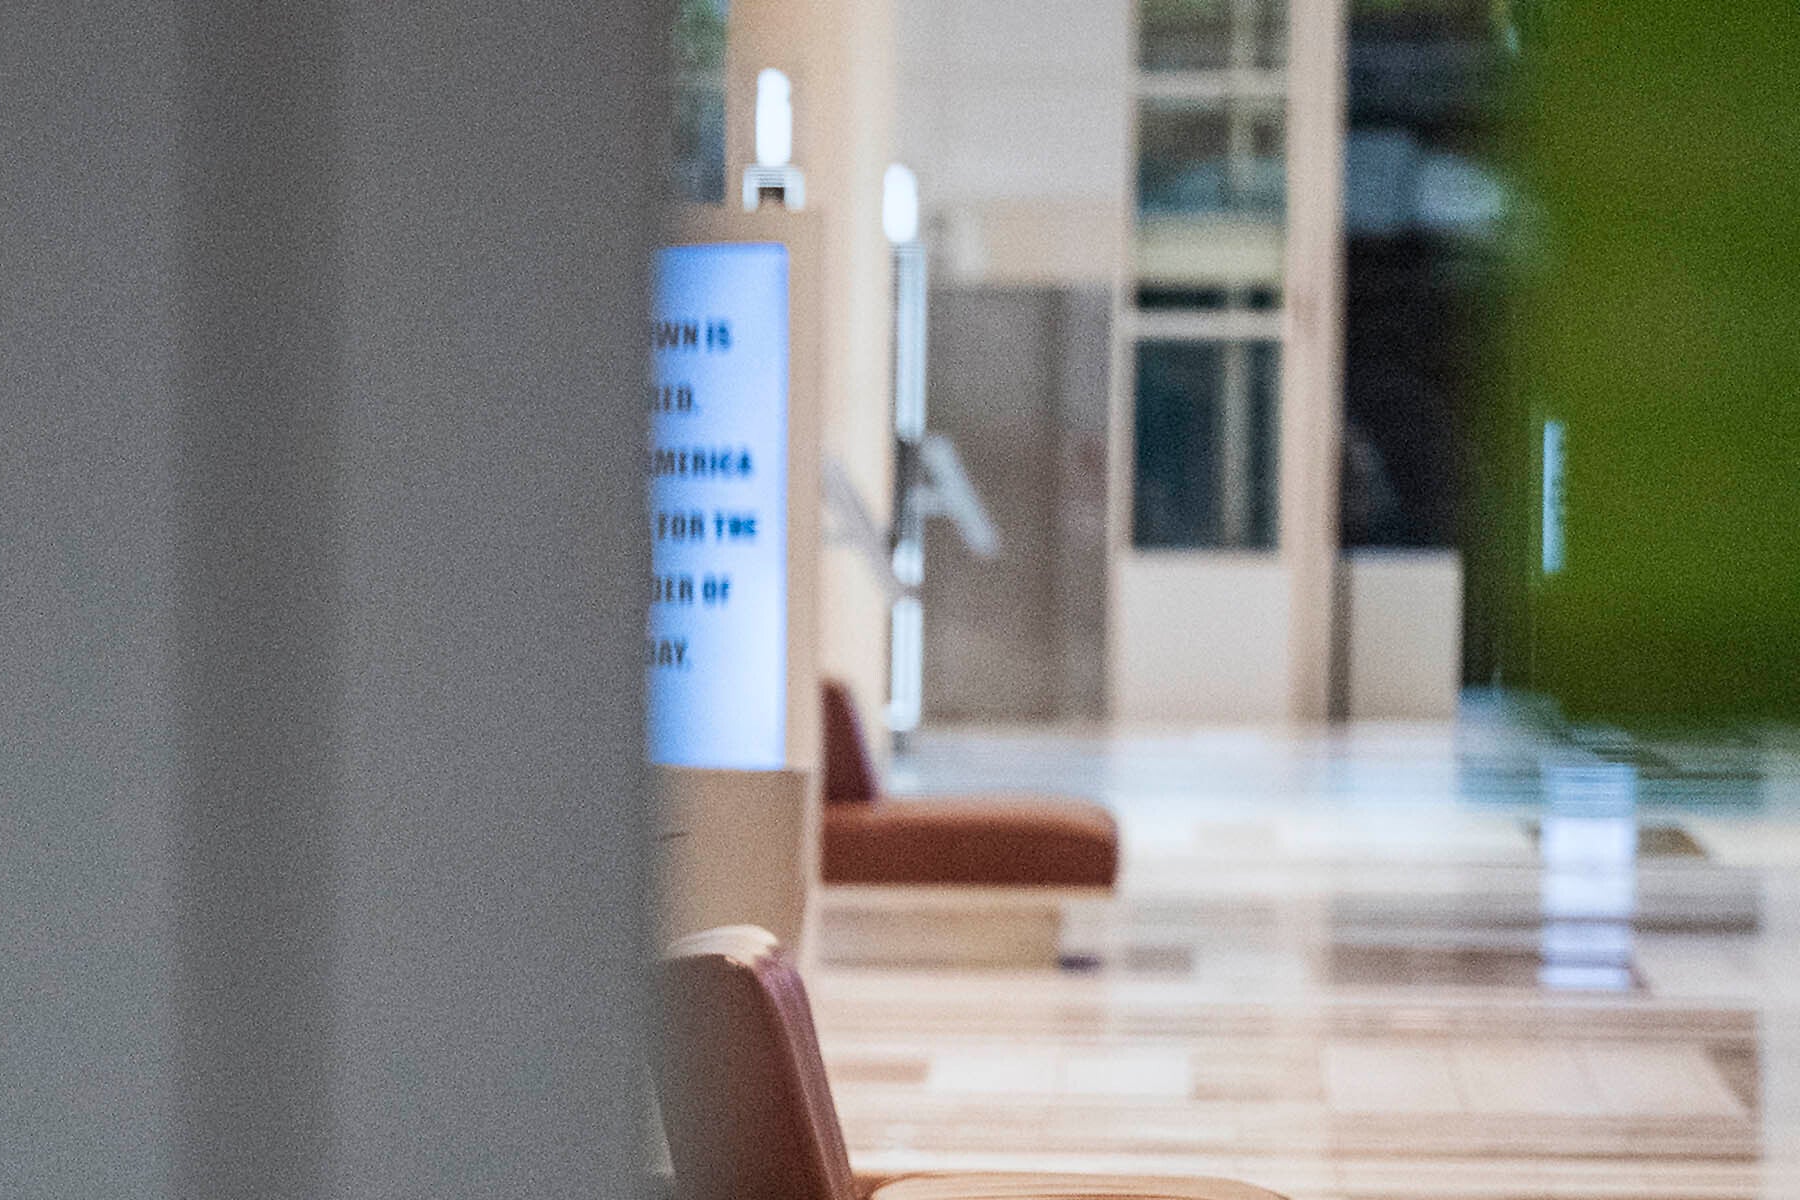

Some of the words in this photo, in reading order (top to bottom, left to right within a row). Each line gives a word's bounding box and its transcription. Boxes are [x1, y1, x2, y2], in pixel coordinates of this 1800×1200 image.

[705, 321, 731, 350] IS
[658, 511, 704, 541] FOR
[702, 575, 730, 604] OF
